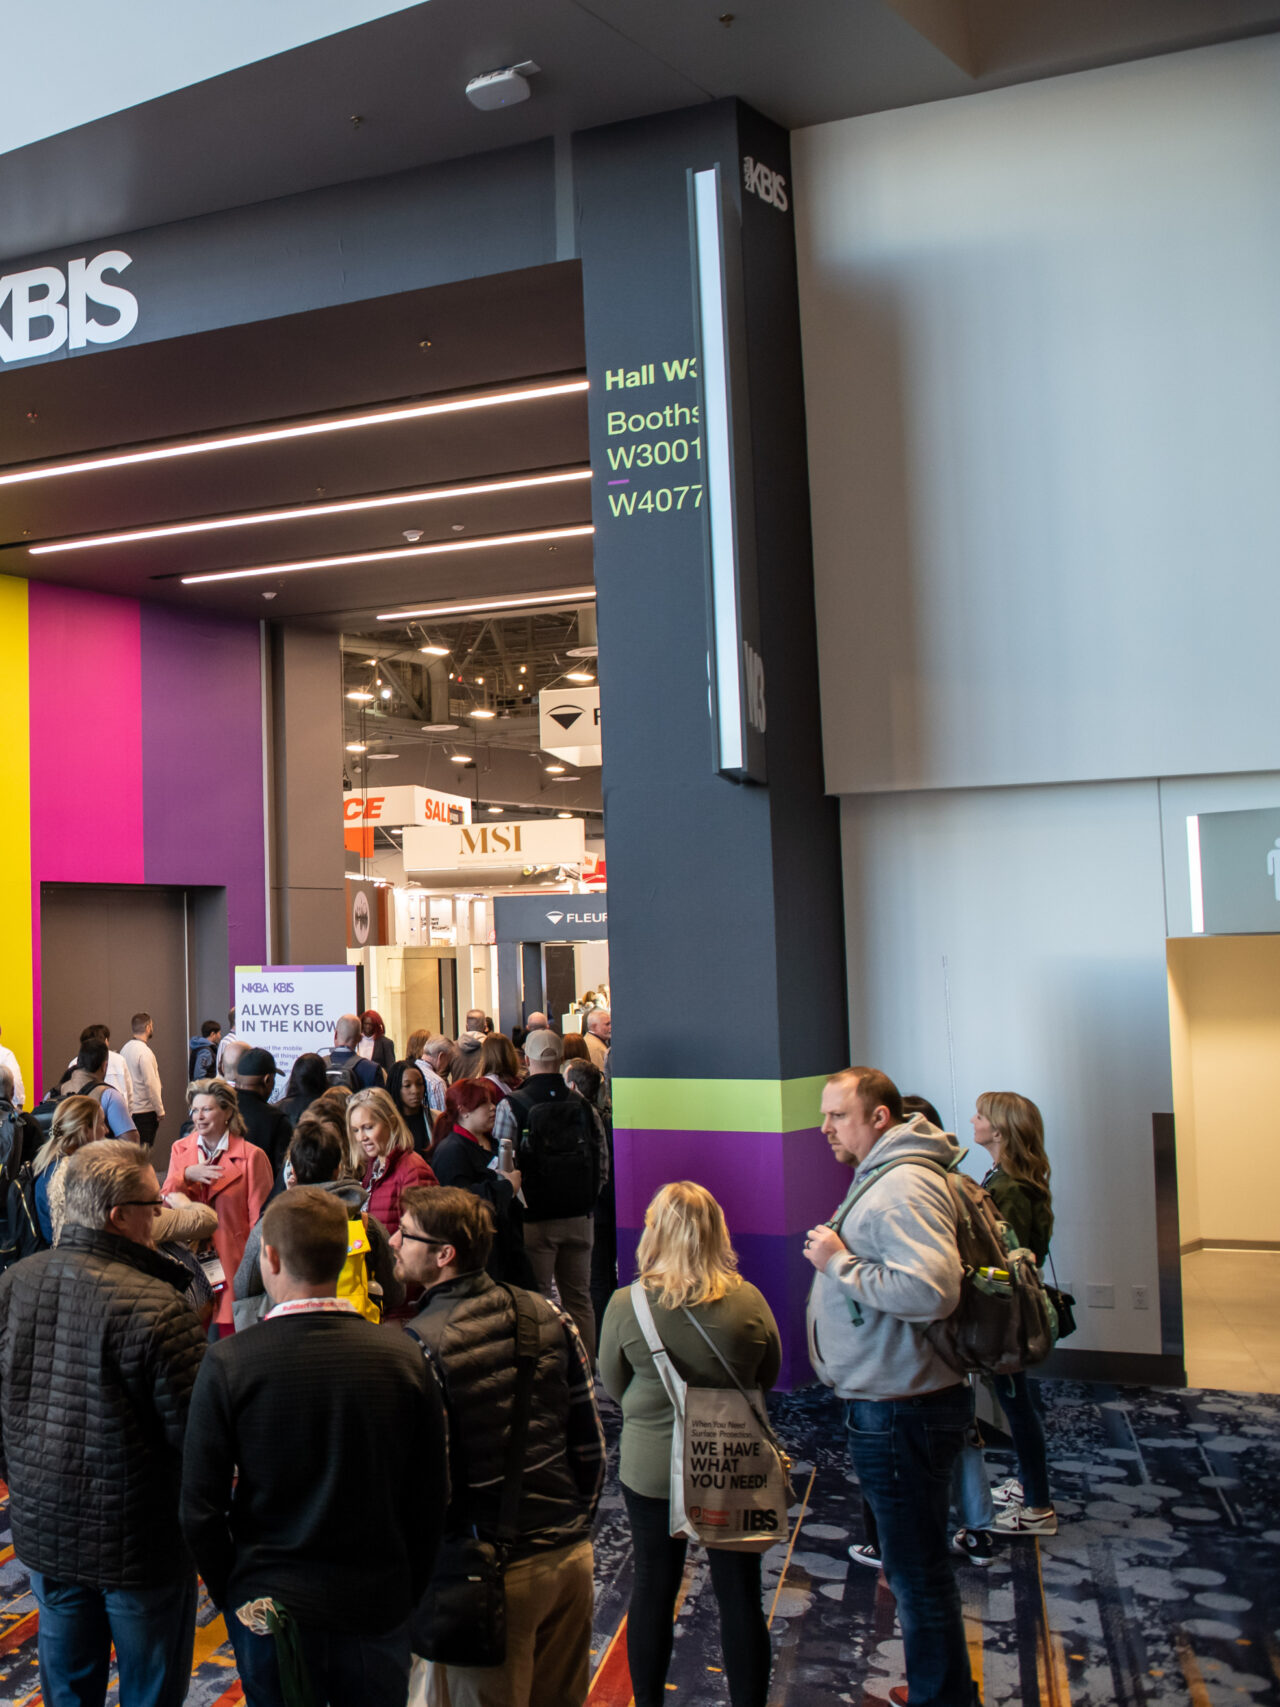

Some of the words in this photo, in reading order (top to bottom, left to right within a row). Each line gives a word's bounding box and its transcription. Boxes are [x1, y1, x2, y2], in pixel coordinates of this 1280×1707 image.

[605, 363, 655, 391] Hall
[607, 435, 701, 471] W3001
[608, 484, 703, 518] W4077
[459, 825, 522, 854] MSI
[241, 982, 269, 993] NKBA
[273, 982, 295, 993] KBIS
[241, 1004, 300, 1016] ALWAYS
[304, 1004, 324, 1016] BE
[242, 1020, 256, 1032] IN
[260, 1020, 289, 1032] THE
[293, 1020, 337, 1032] KNOW
[691, 1440, 718, 1456] WE
[723, 1442, 760, 1457] HAVE
[690, 1458, 739, 1473] WHAT
[690, 1474, 726, 1489] YOU
[729, 1474, 768, 1490] NEED!
[743, 1509, 779, 1532] IBS
